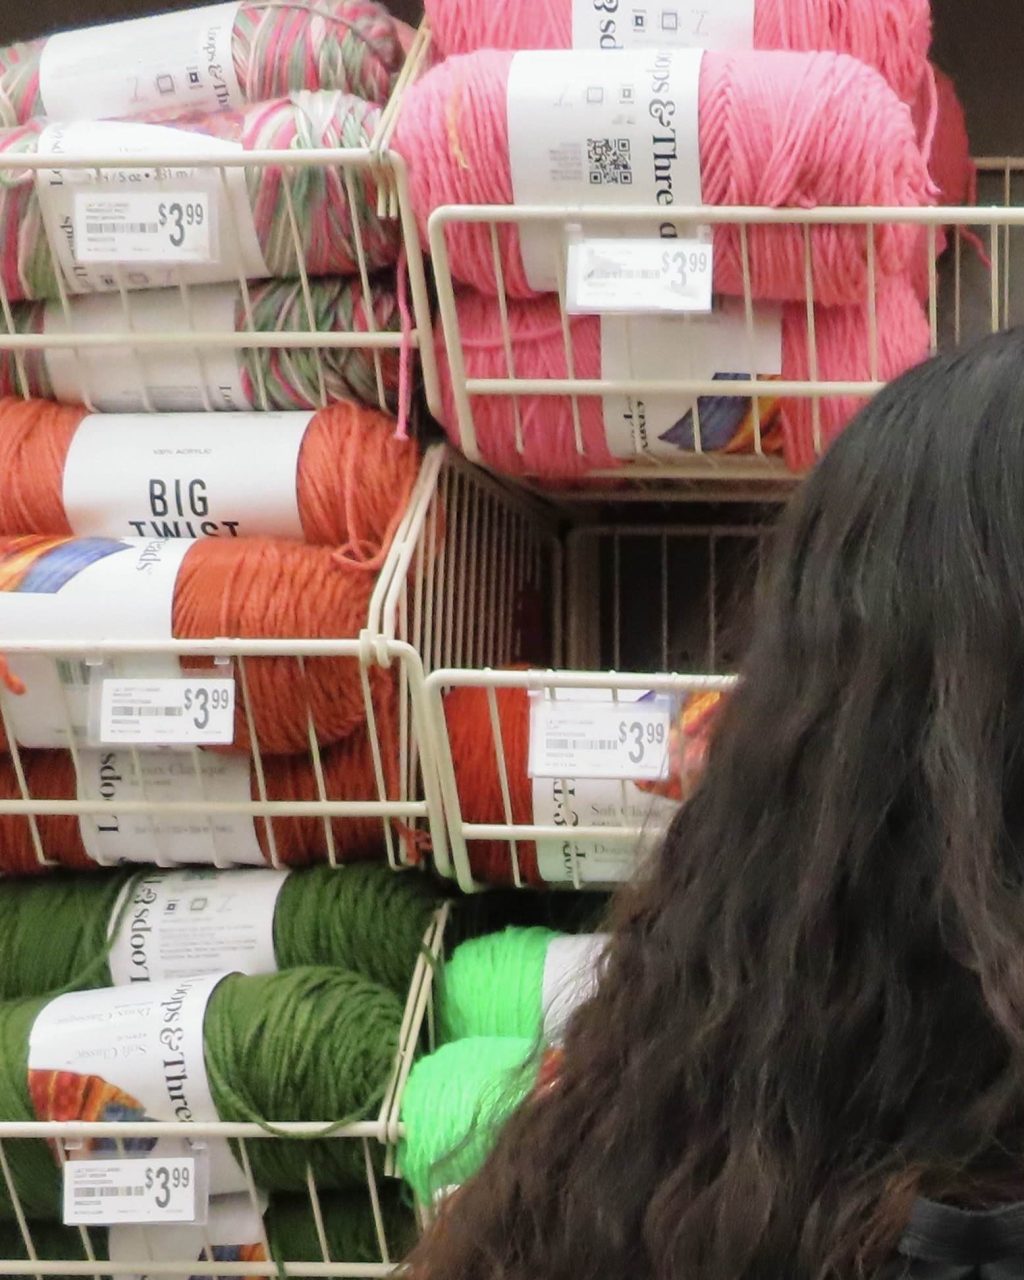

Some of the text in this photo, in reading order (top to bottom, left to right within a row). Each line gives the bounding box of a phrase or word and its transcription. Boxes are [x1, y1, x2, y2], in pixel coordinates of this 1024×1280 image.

[648, 98, 675, 128] &
[149, 478, 208, 517] BIG
[97, 752, 122, 833] Lops
[129, 908, 152, 984] Loops
[159, 1027, 185, 1051] &
